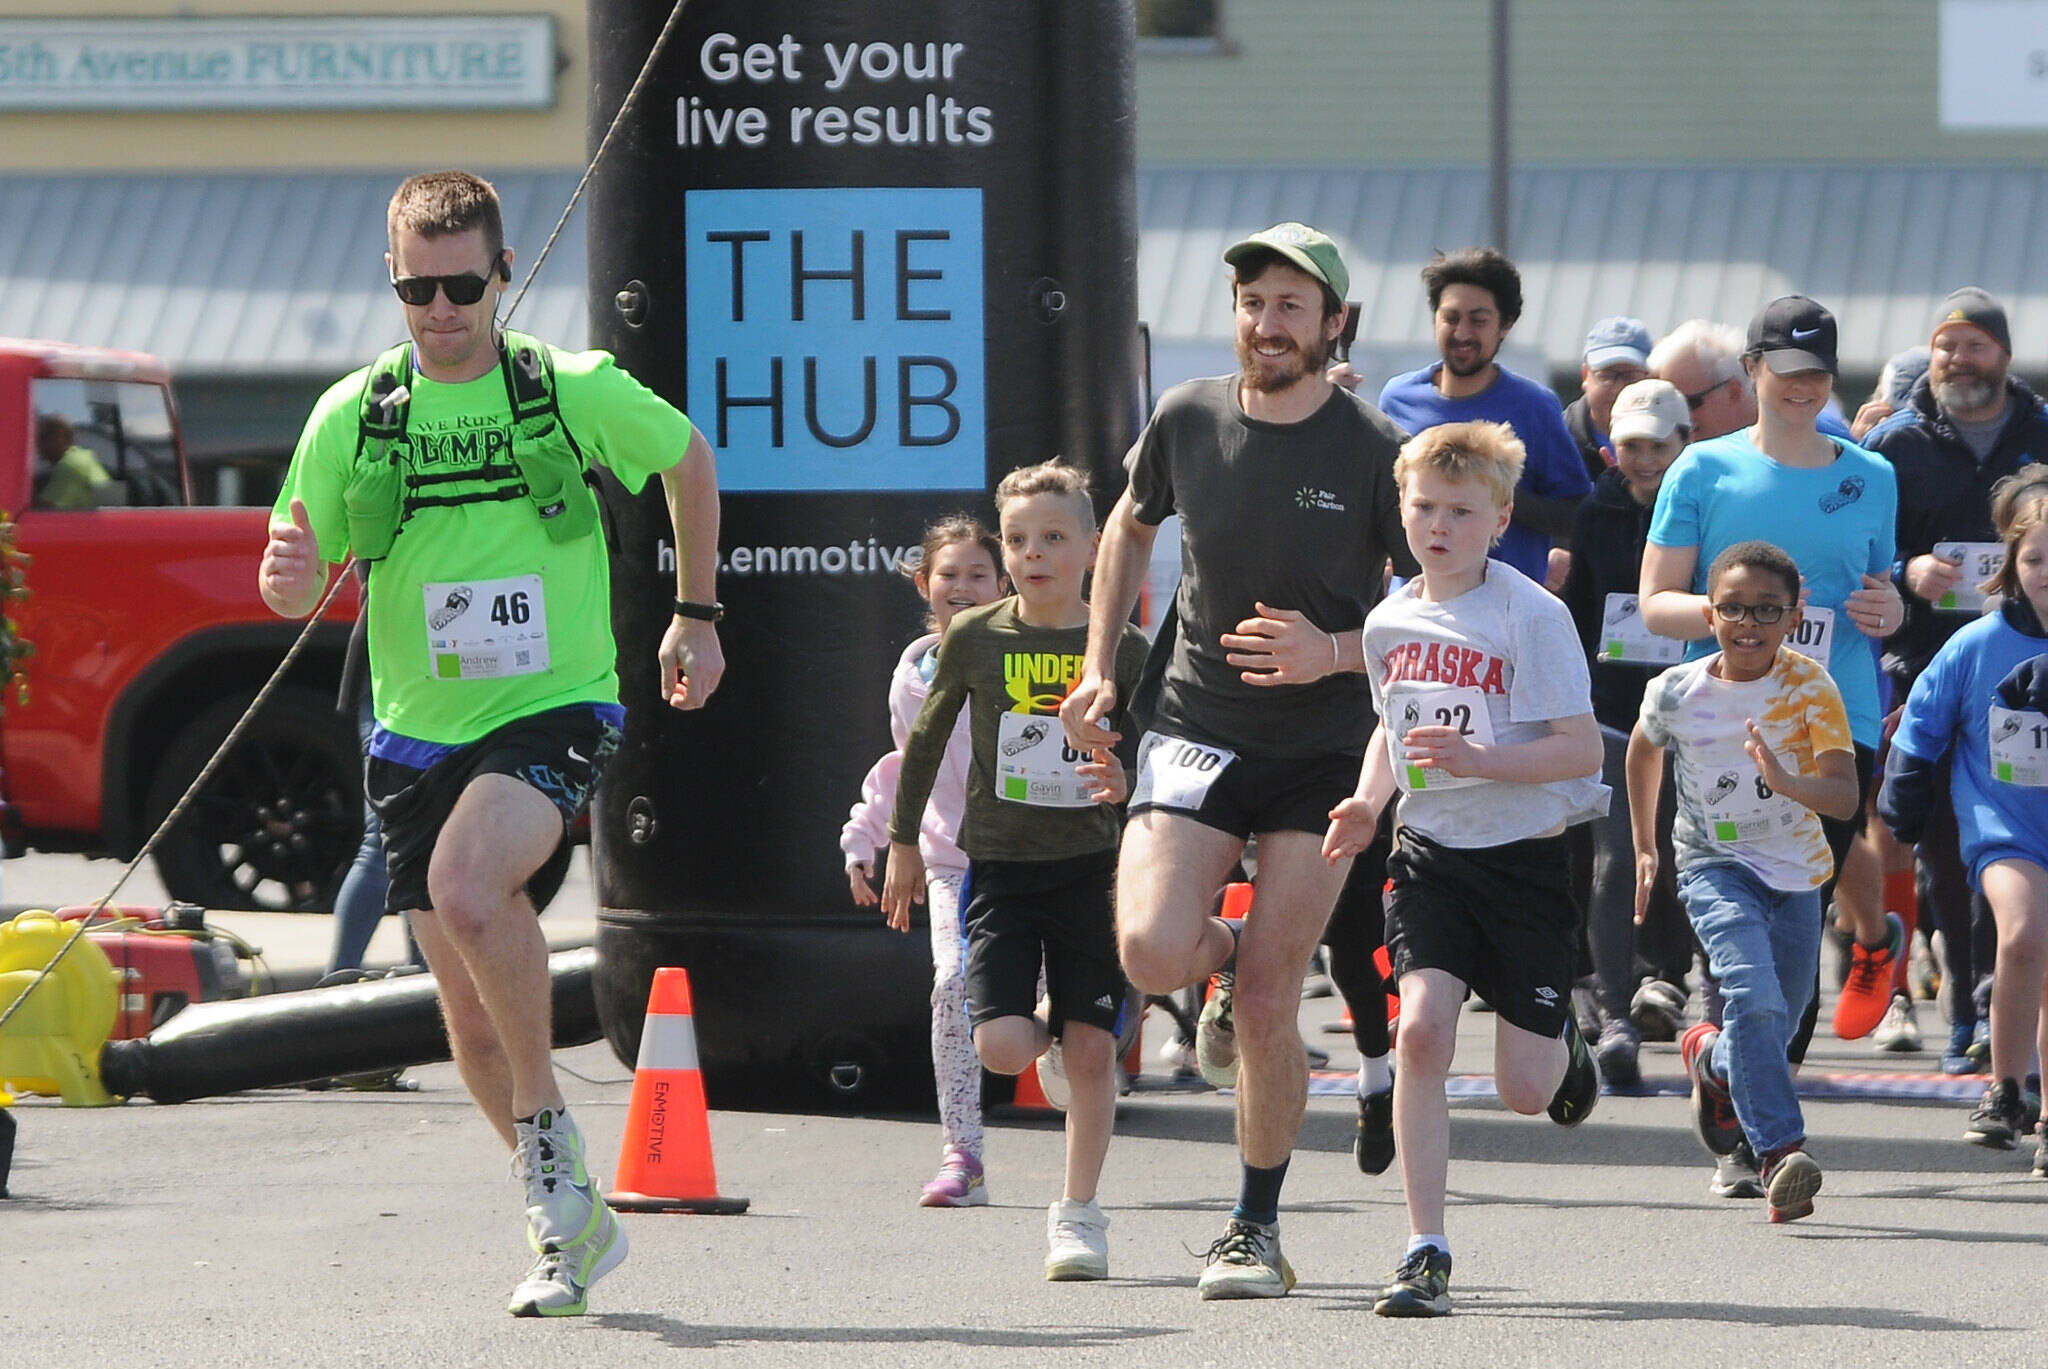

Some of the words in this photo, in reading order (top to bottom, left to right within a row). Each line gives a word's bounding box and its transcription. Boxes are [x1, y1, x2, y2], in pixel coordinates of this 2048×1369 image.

[71, 42, 234, 81] Avenue
[244, 42, 526, 81] FURNITURE
[700, 32, 803, 82] Get
[822, 41, 965, 90] your
[676, 96, 768, 146] live
[790, 93, 994, 145] results
[706, 229, 951, 321] THE
[715, 355, 961, 448] HUB
[658, 538, 926, 573] h.enmotive
[491, 591, 530, 626] 46
[1168, 744, 1221, 771] 100
[1030, 782, 1062, 793] Gavin
